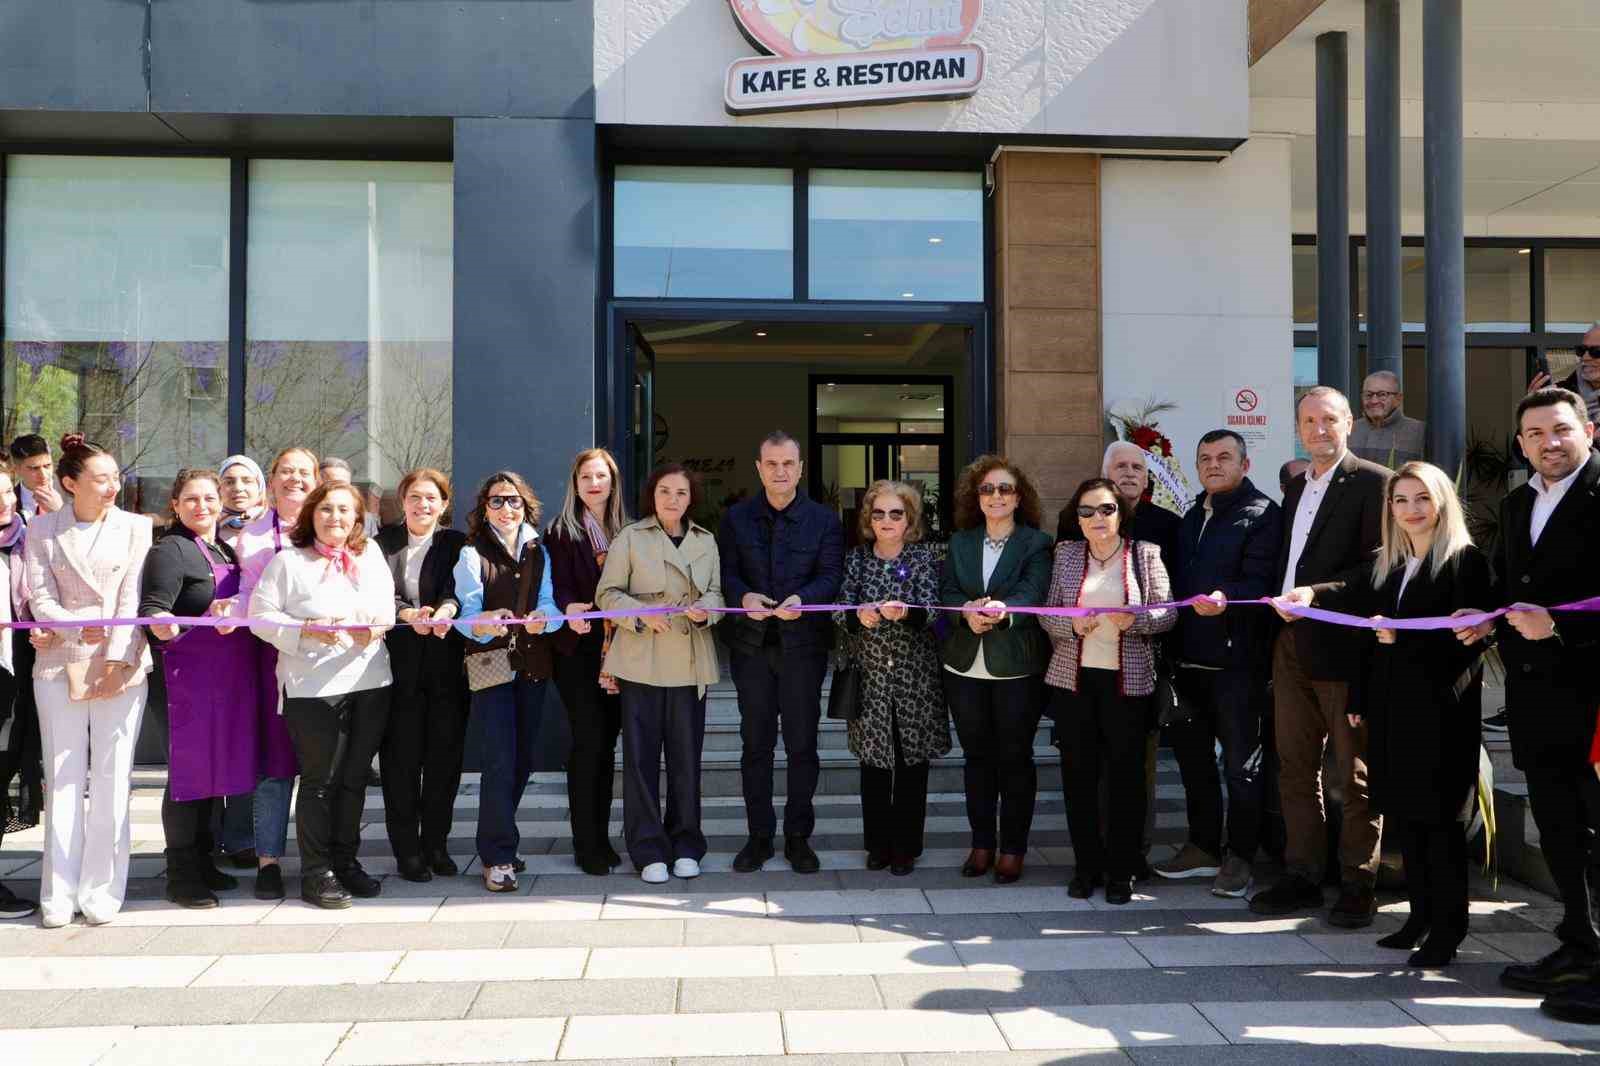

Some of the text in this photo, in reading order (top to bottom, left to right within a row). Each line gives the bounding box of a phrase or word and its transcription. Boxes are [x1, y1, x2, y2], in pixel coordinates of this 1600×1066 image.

[742, 57, 966, 94] KAFE & RESTORAN
